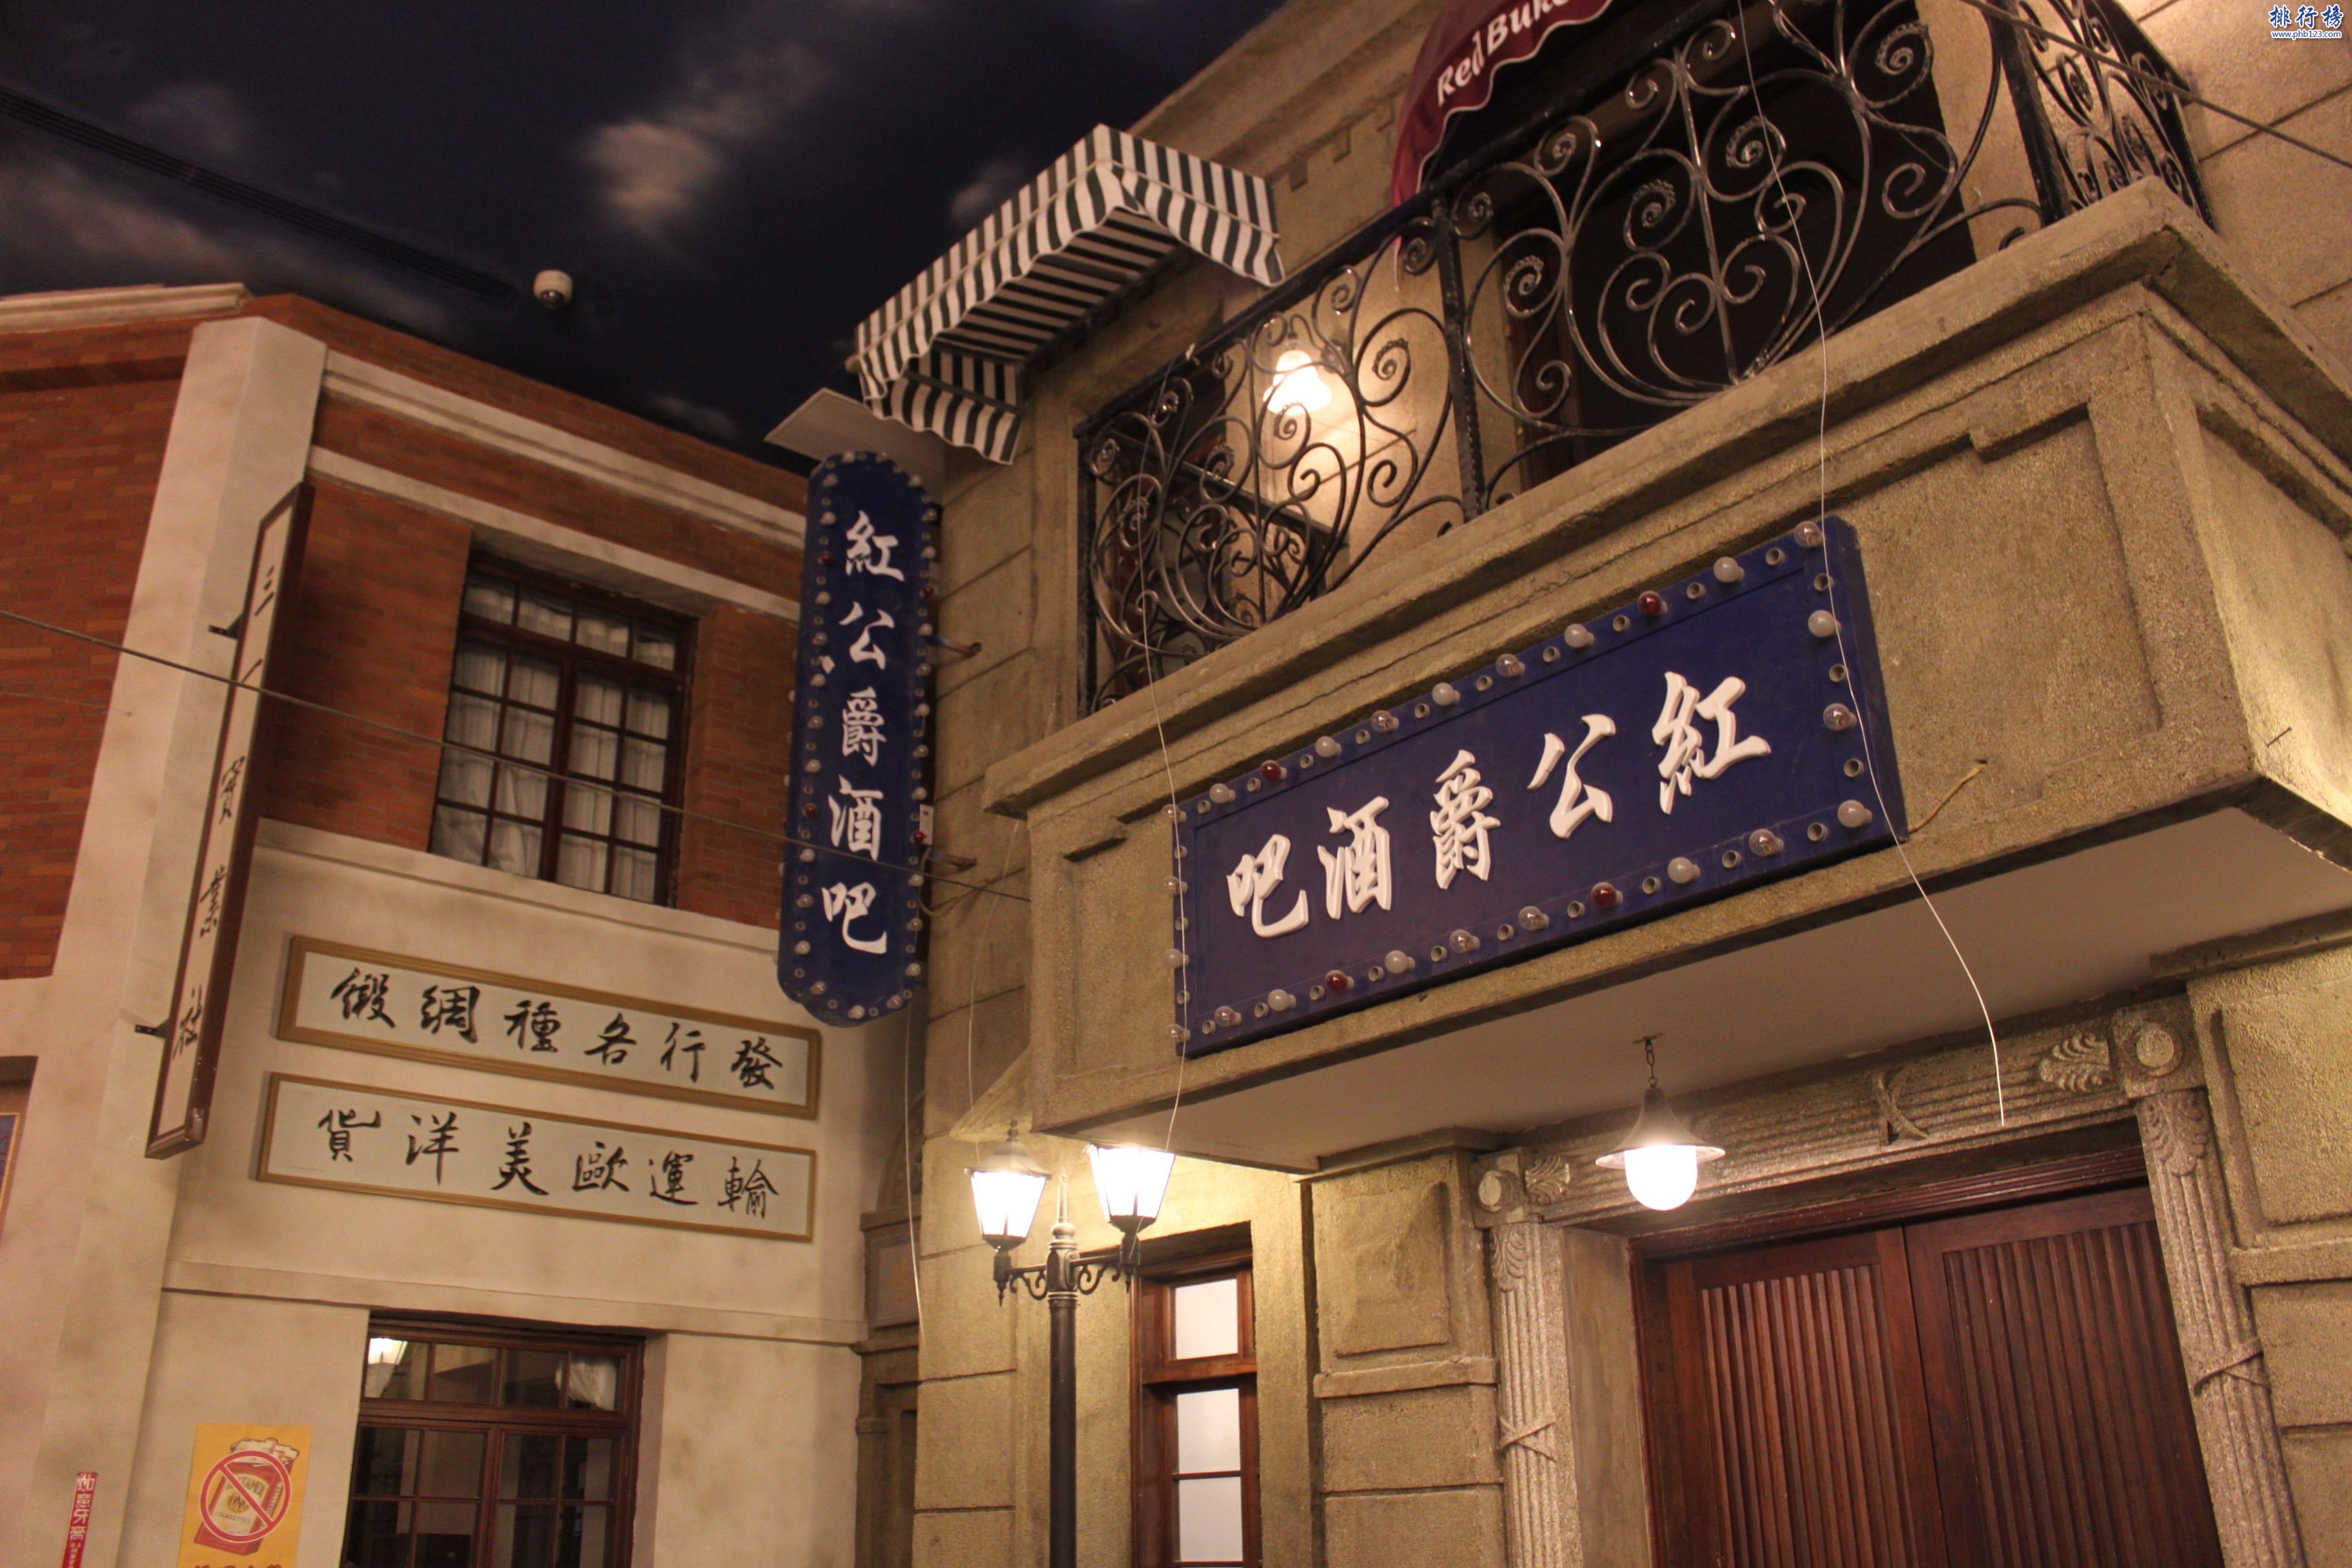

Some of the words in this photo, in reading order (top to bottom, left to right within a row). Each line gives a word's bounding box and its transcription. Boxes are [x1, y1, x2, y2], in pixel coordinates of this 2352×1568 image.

[1437, 30, 1485, 107] Red
[822, 512, 903, 953] 紅公爵酒吧
